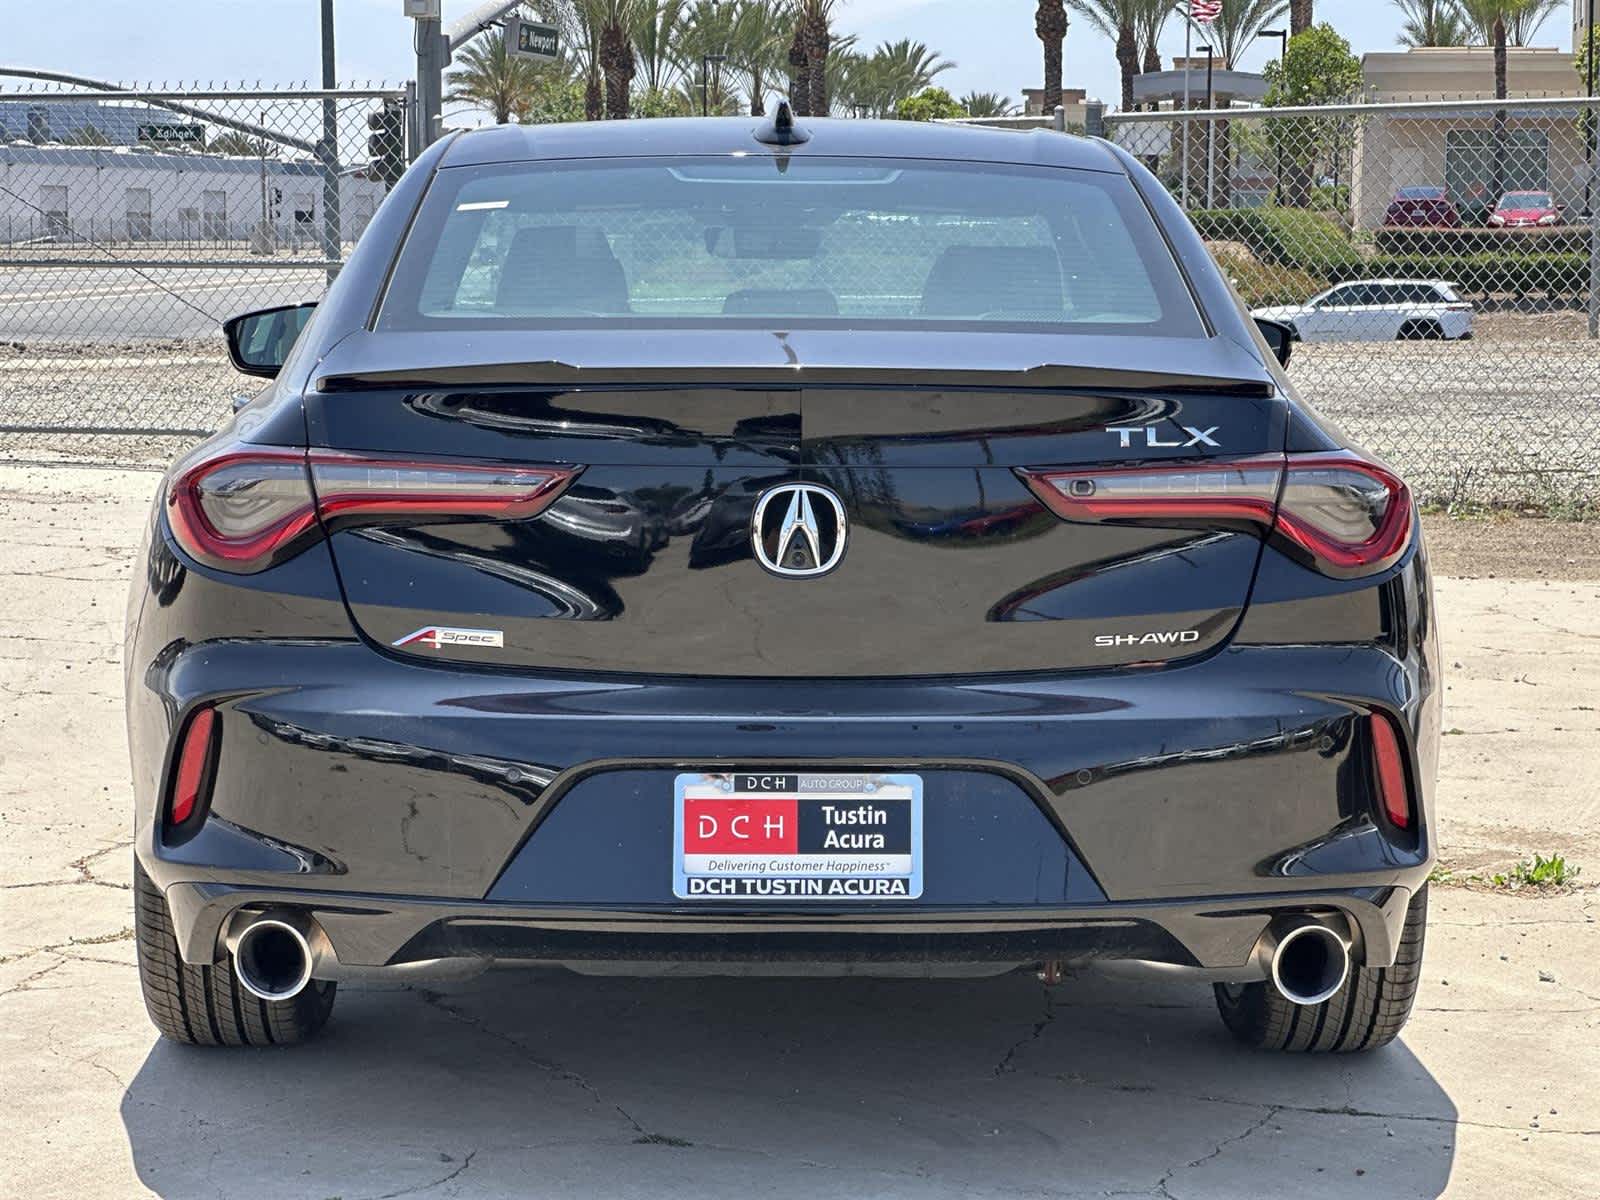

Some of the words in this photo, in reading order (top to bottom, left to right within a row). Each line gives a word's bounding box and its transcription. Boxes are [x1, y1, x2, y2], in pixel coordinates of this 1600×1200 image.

[529, 31, 556, 53] Newport
[1105, 426, 1222, 448] TLX
[1094, 630, 1200, 647] SH-AWD
[747, 776, 786, 790] DCH
[800, 778, 829, 789] AUTO
[828, 778, 863, 790] GROUP
[821, 805, 887, 826] Tustin
[699, 815, 784, 839] DCH
[823, 830, 885, 849] Acura
[708, 859, 766, 874] Delivering
[769, 860, 823, 872] Customer
[689, 878, 736, 895] DCH
[741, 878, 823, 895] TUSTIN
[828, 878, 906, 895] ACURA
